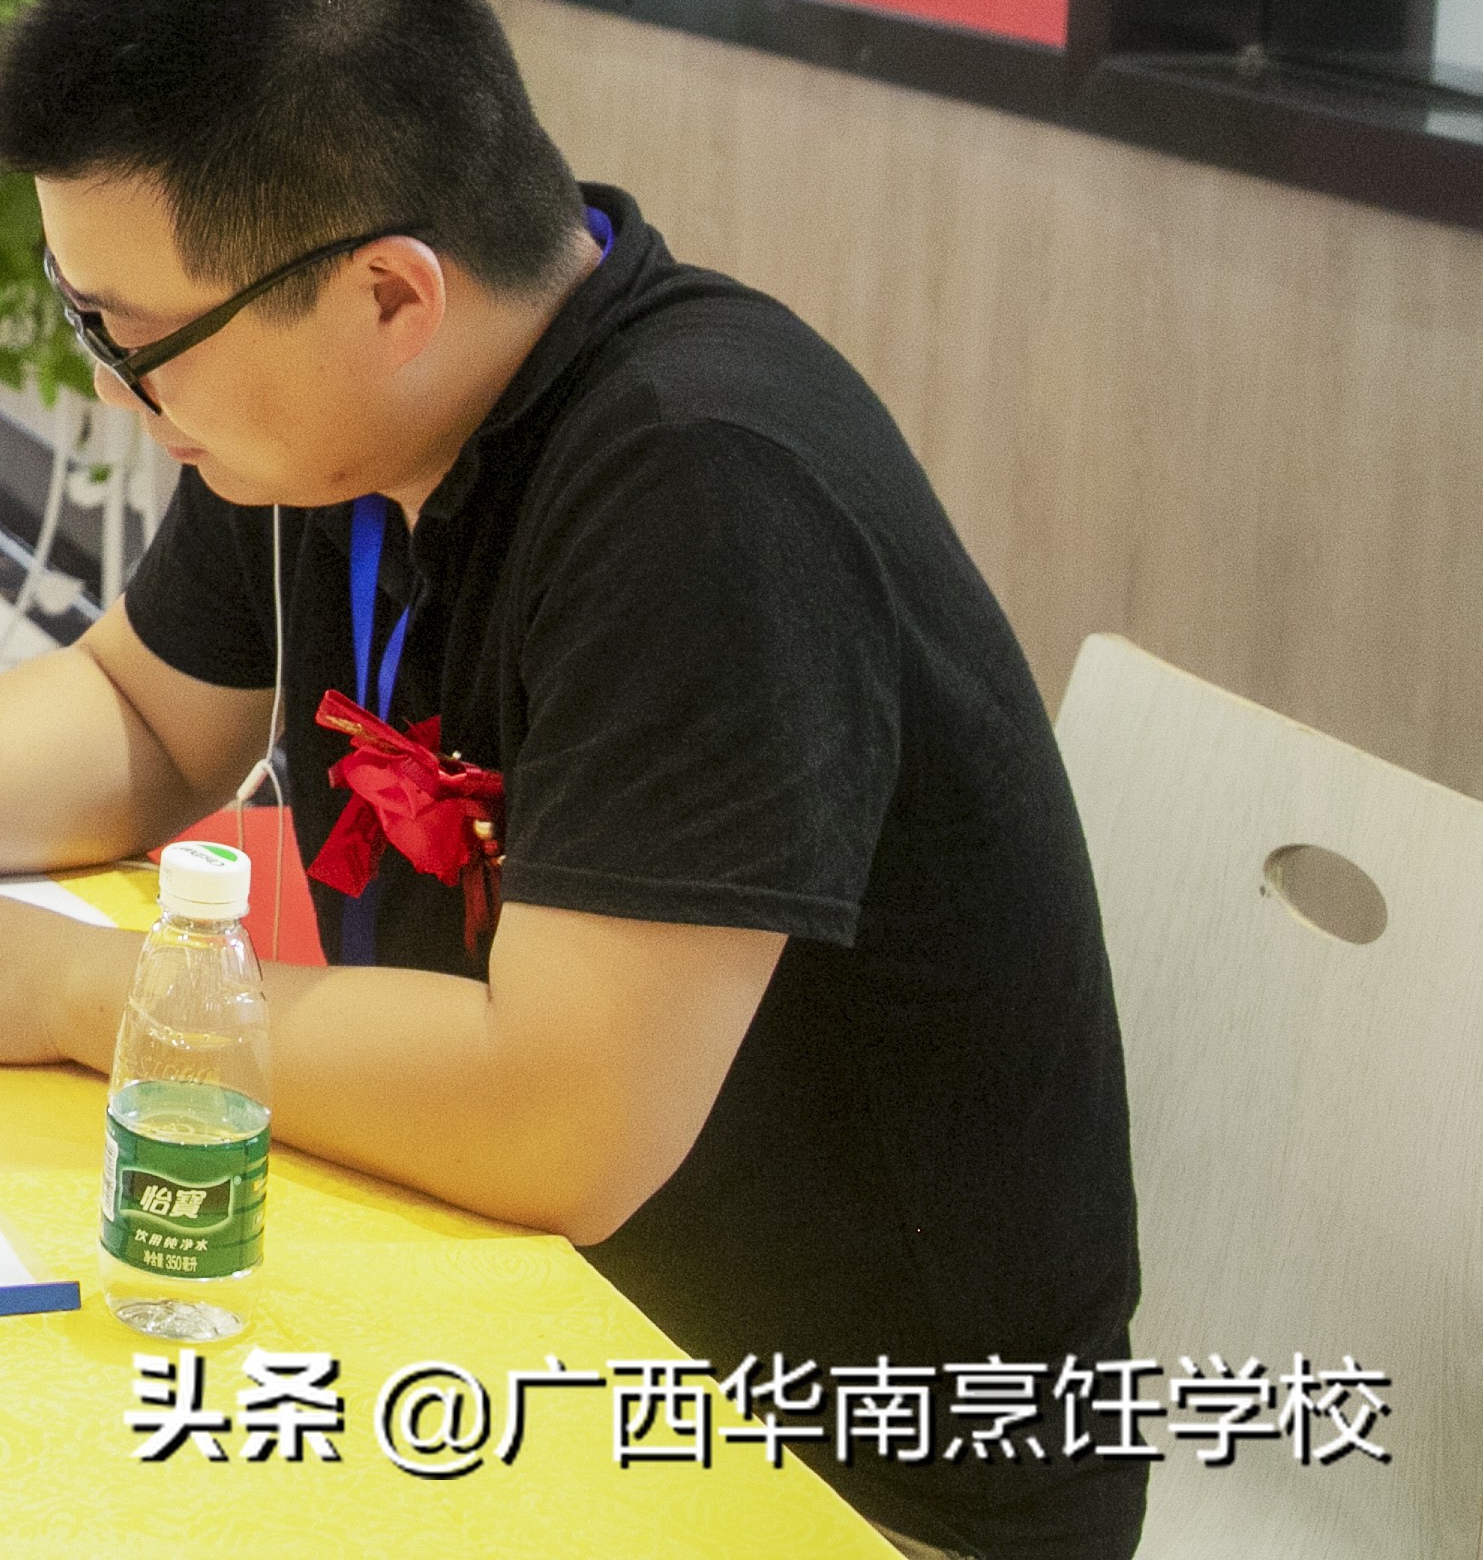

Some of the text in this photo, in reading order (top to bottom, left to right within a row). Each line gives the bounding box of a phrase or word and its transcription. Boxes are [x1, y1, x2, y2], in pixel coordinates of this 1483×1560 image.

[134, 1228, 209, 1252] 饮用纯净水
